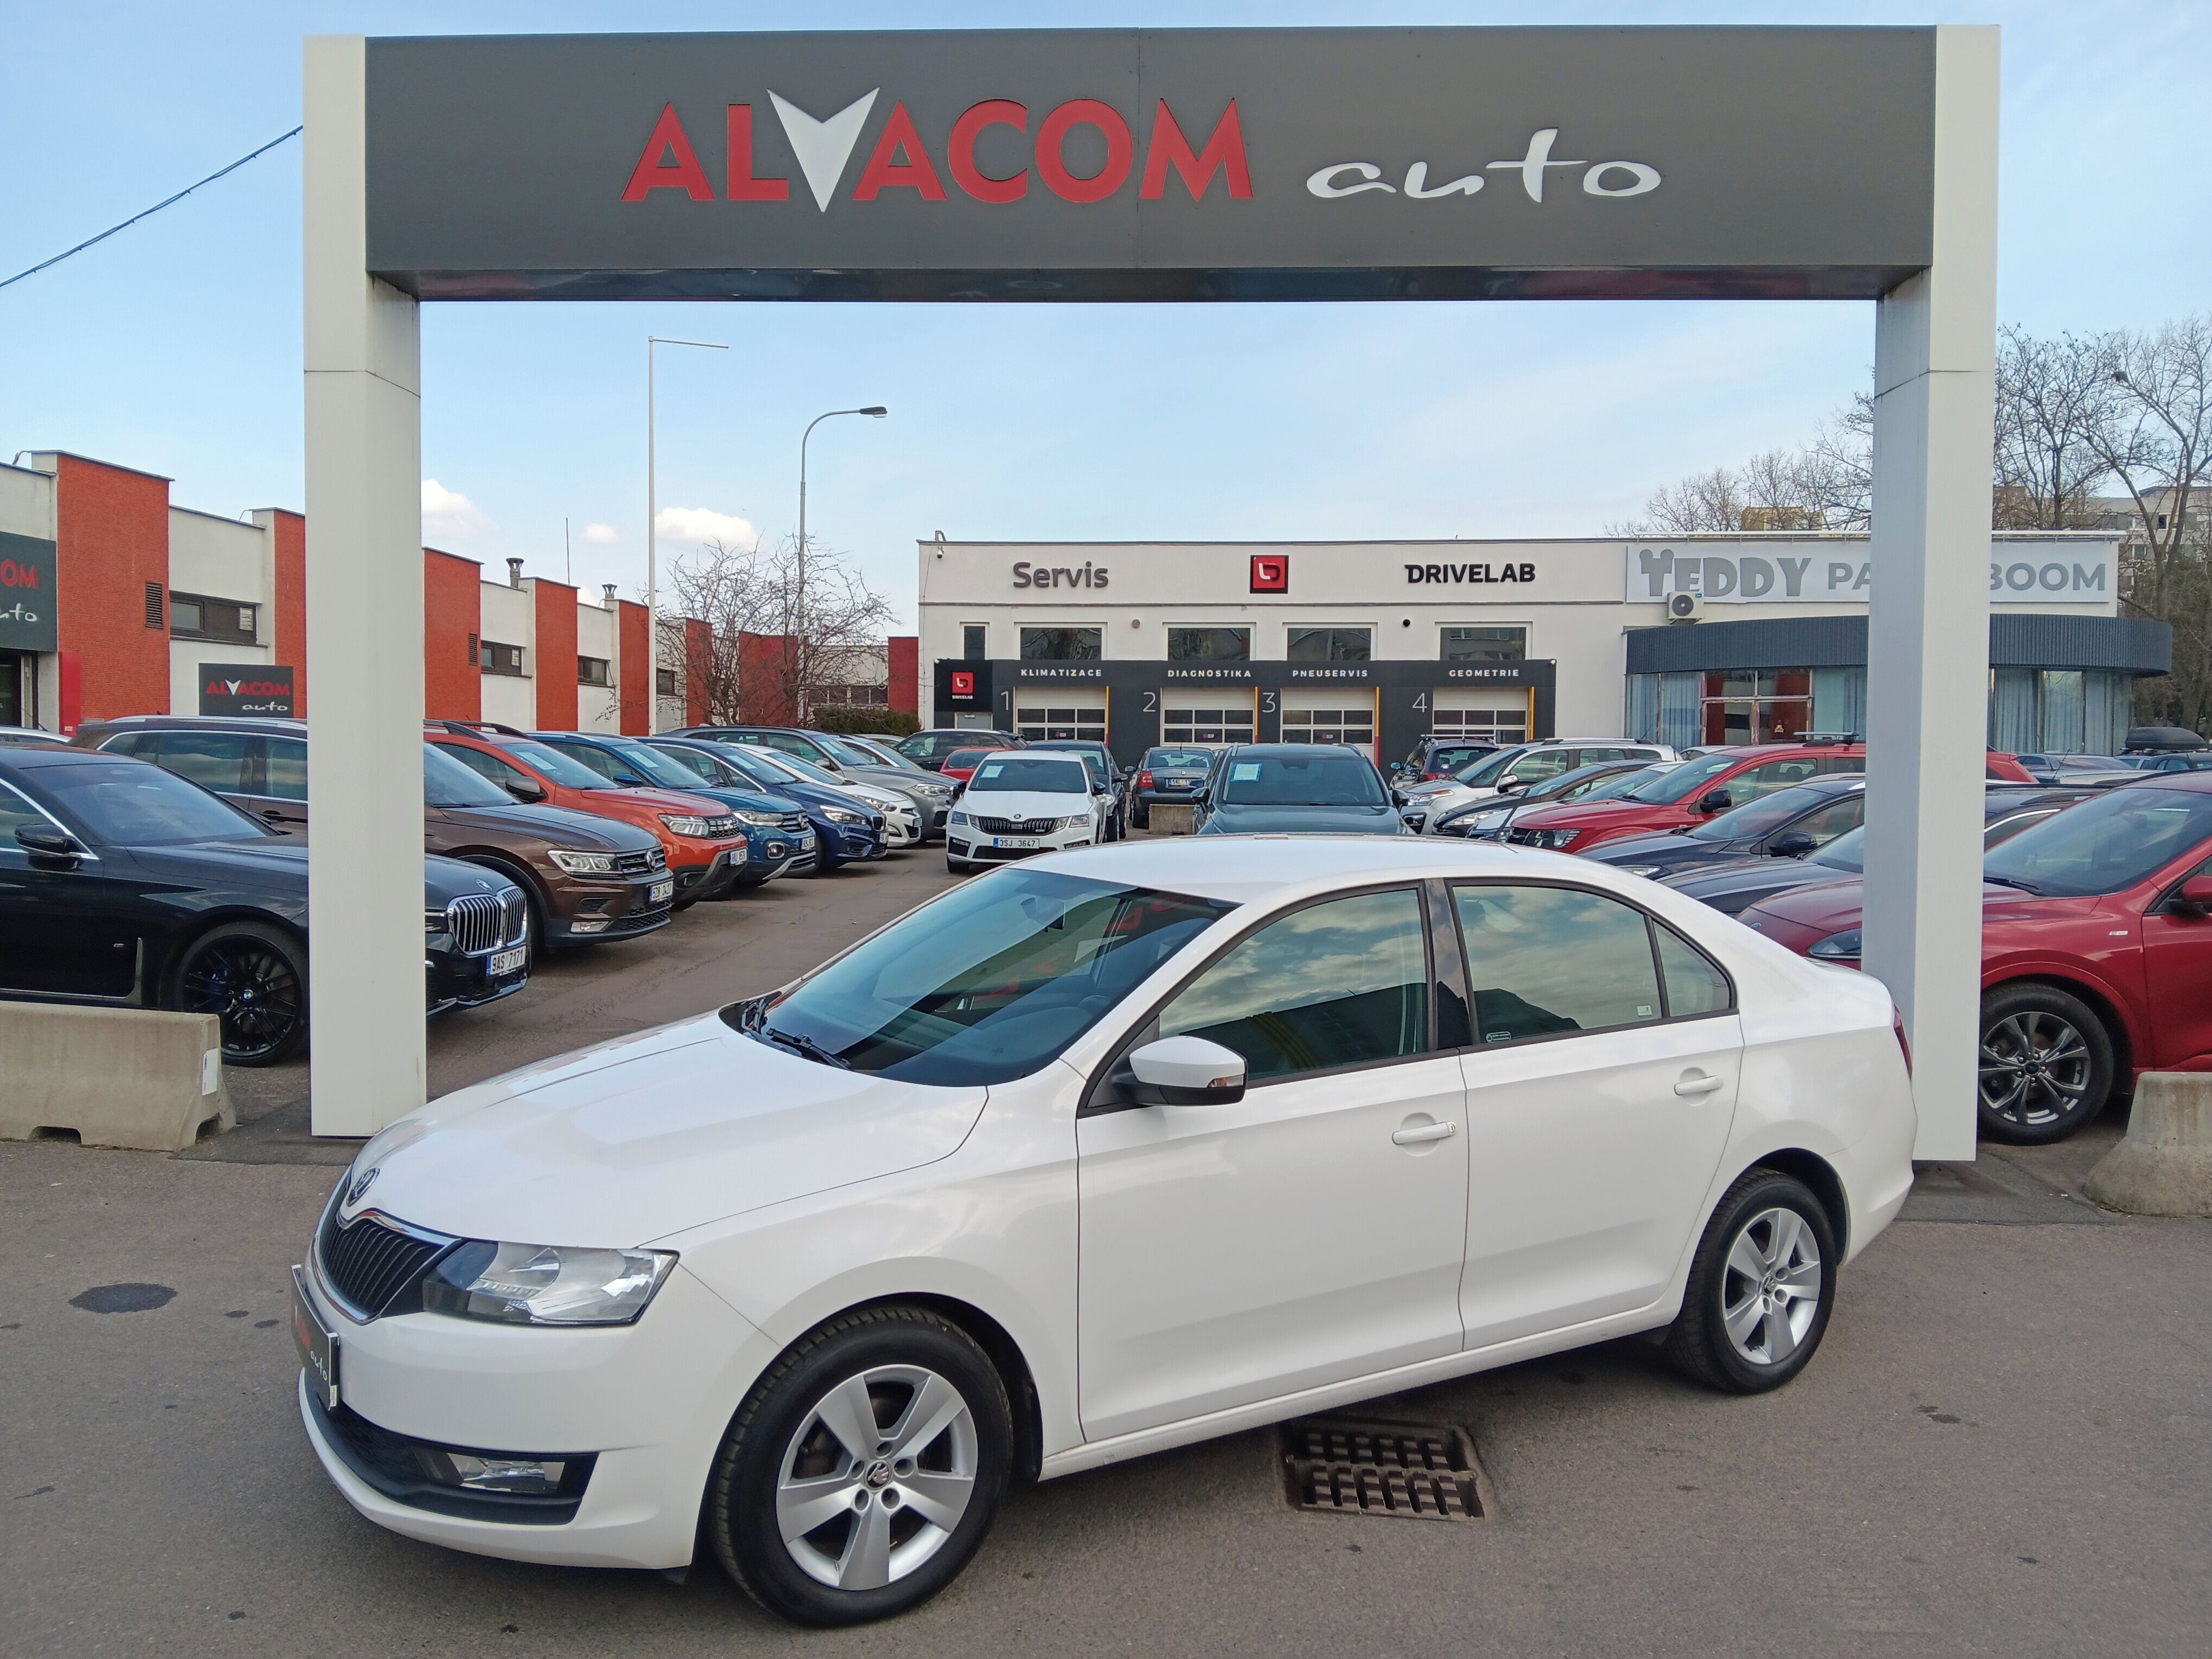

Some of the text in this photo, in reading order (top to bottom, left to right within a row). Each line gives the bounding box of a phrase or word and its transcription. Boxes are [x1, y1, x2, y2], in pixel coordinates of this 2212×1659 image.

[620, 86, 1661, 213] ALVACOM auto
[1013, 561, 1109, 588] Servis
[1405, 563, 1535, 583] DRIVELAB
[1639, 549, 1812, 597] TEDDY
[1449, 669, 1520, 677] GEOMETRIE
[206, 679, 291, 696] ALVACOM
[242, 701, 288, 711] auto
[1000, 691, 1009, 711] 1
[1142, 691, 1156, 712] 2
[1262, 691, 1276, 713] 3
[1412, 692, 1427, 713] 4
[492, 949, 523, 972] 9AS 7171
